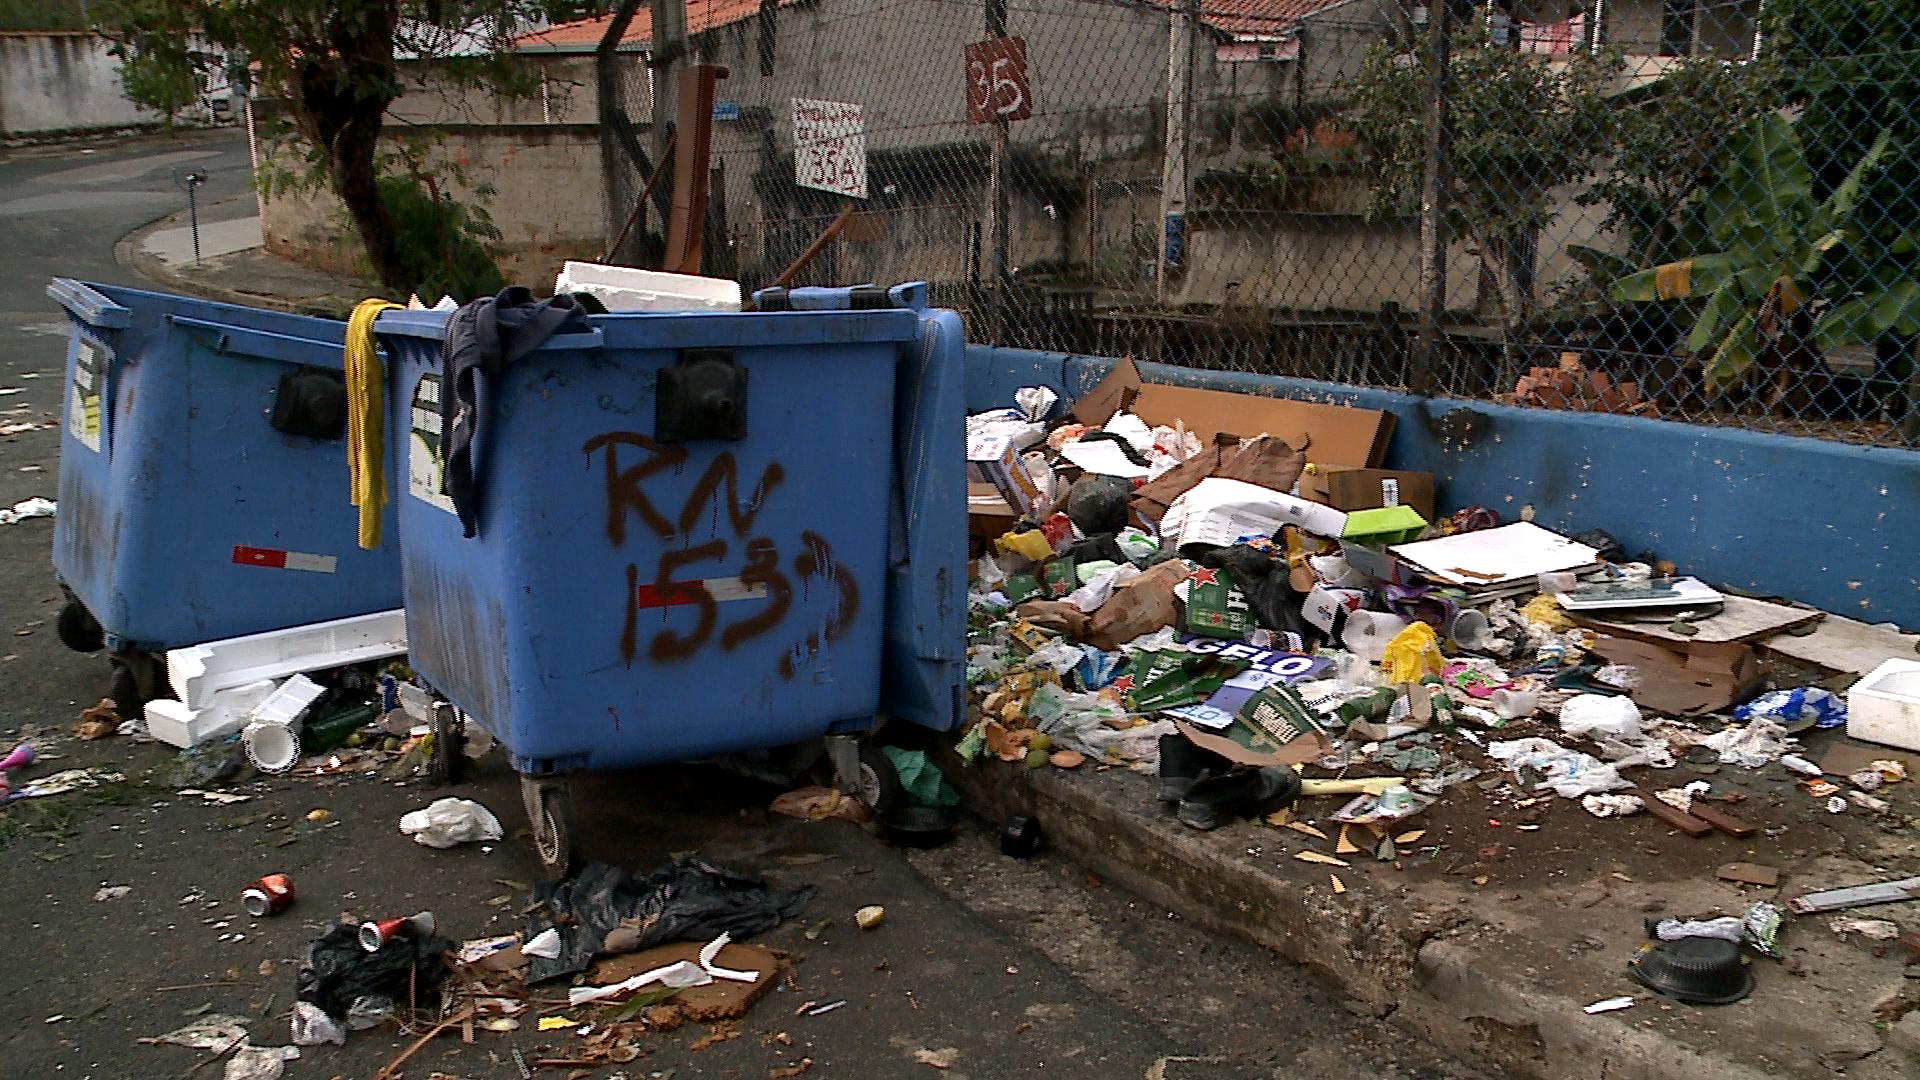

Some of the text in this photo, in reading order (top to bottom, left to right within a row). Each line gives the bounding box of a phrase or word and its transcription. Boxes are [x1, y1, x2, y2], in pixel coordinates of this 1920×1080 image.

[971, 57, 1023, 110] 35
[811, 148, 857, 185] 35A
[583, 431, 786, 547] RN
[1187, 638, 1315, 675] GELO
